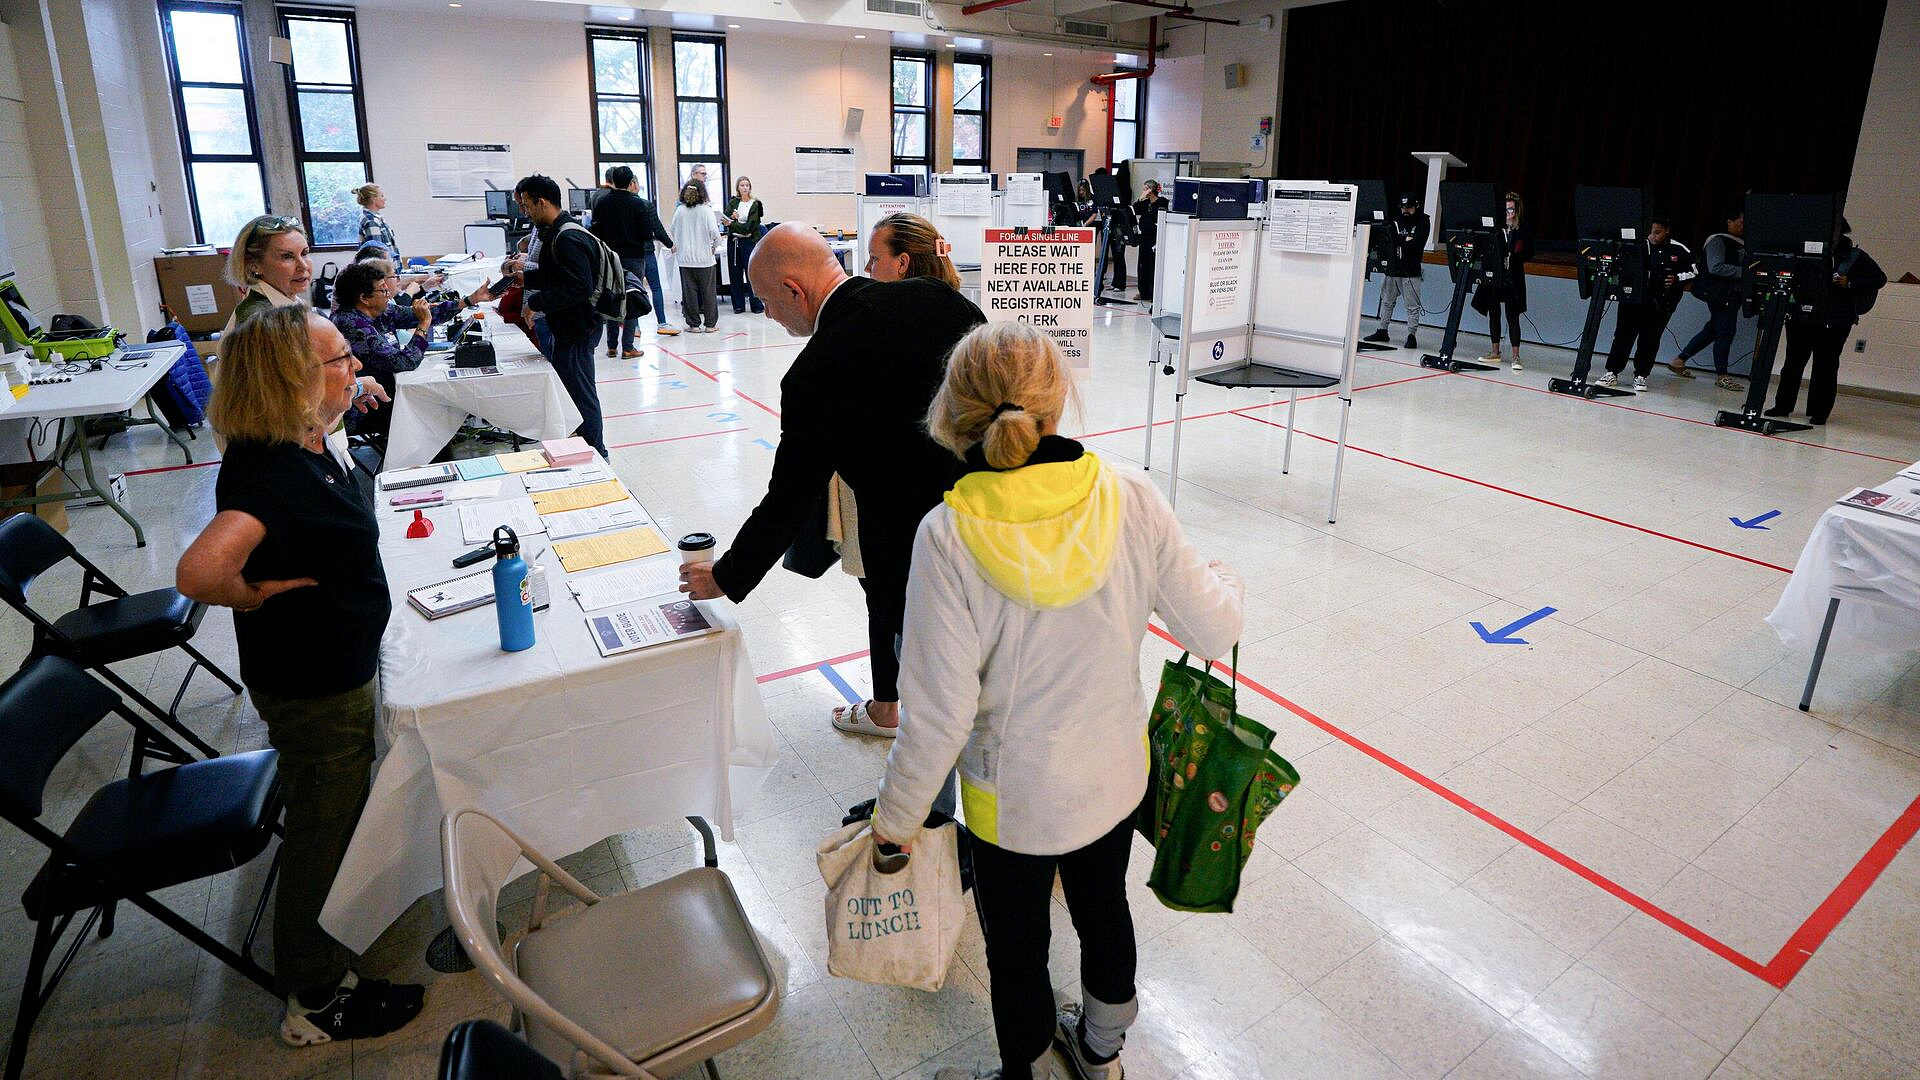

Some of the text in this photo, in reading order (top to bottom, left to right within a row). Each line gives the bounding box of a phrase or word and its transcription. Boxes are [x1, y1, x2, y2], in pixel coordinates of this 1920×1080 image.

[1032, 233, 1060, 241] SINGLE
[1061, 233, 1079, 241] LINE
[998, 245, 1080, 257] PLEASE WAIT
[994, 263, 1083, 274] HERE FOR THE
[987, 280, 1089, 292] NEXT AVAILABLE
[991, 297, 1081, 309] REGISTRATION
[1018, 314, 1059, 326] CLERK
[847, 888, 914, 916] OUT TO
[847, 911, 922, 940] LUNCH
